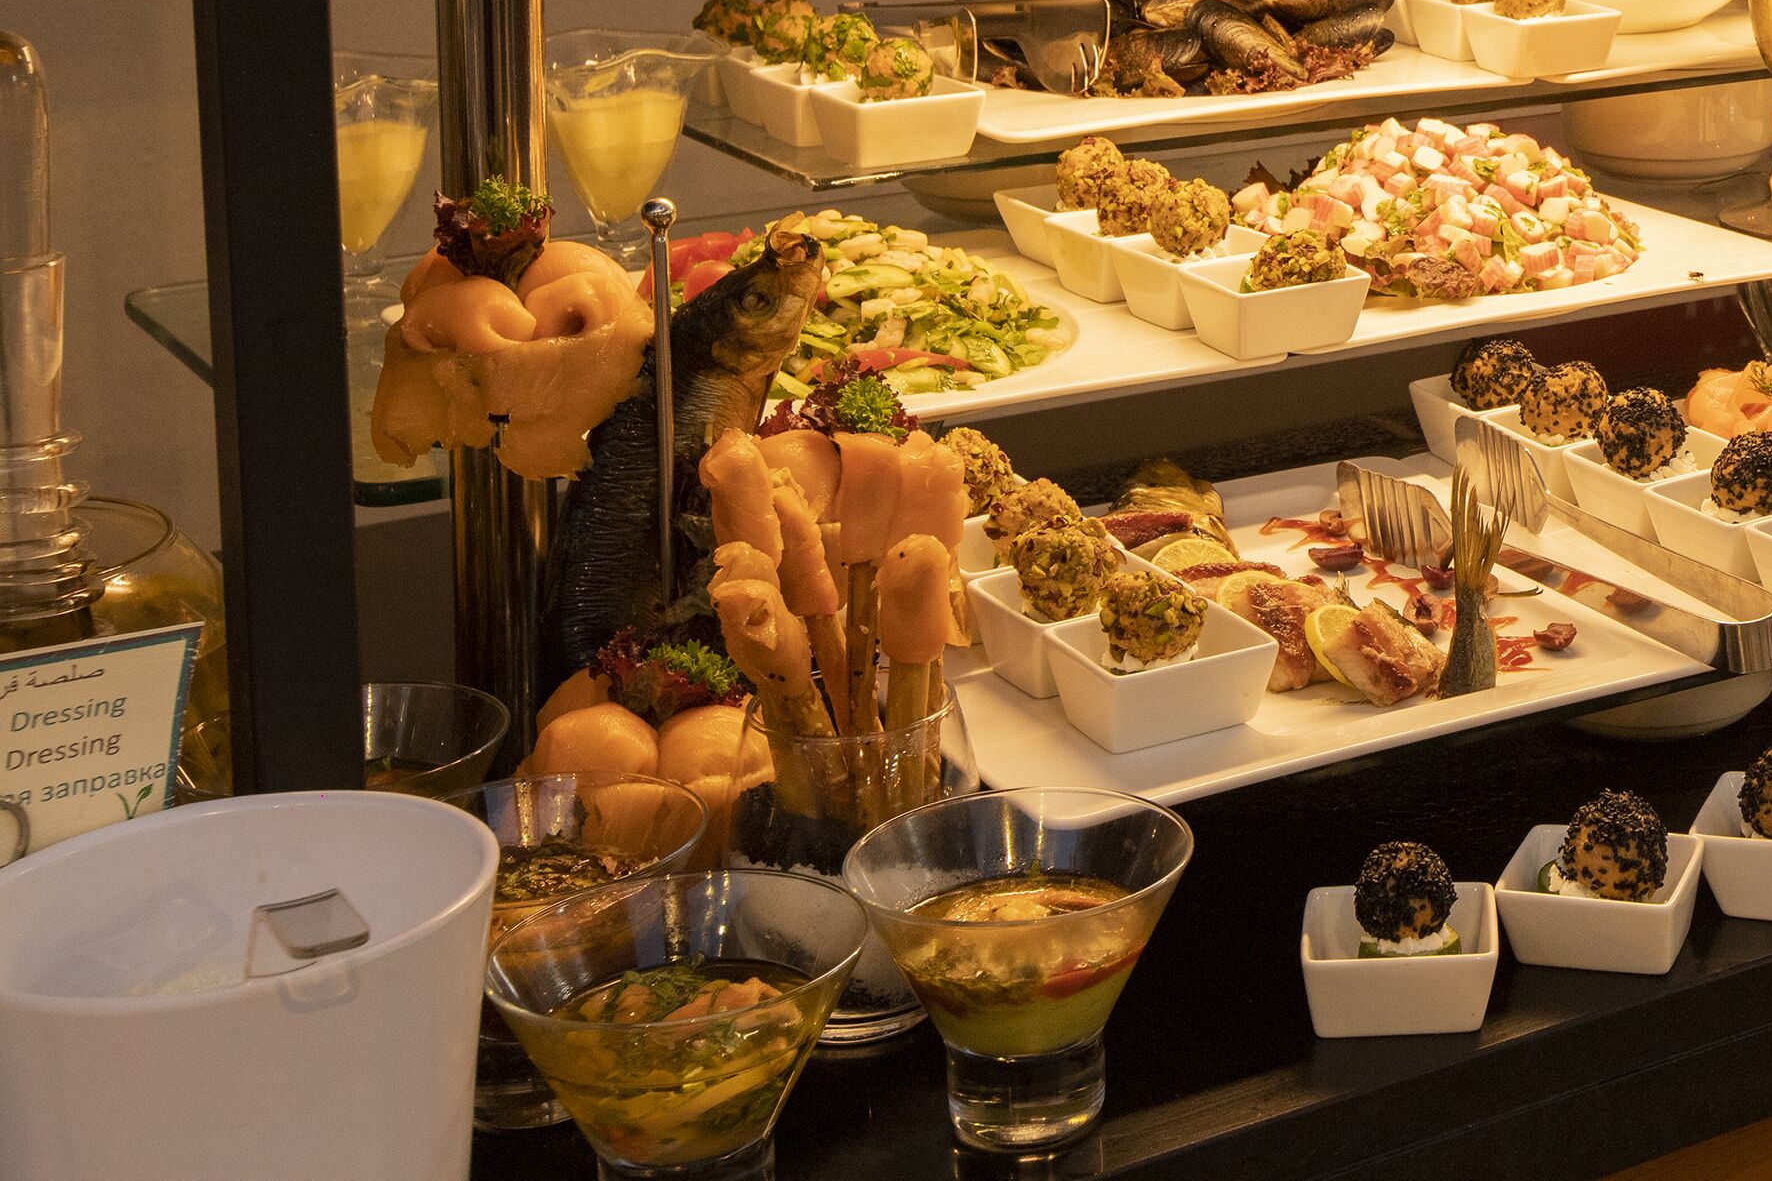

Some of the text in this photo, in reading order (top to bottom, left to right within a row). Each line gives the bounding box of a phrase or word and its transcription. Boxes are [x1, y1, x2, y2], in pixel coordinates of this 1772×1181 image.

[25, 664, 105, 688] صلصة
[10, 697, 127, 732] Dressing
[5, 734, 122, 771] Dressing
[40, 762, 167, 802] заправка
